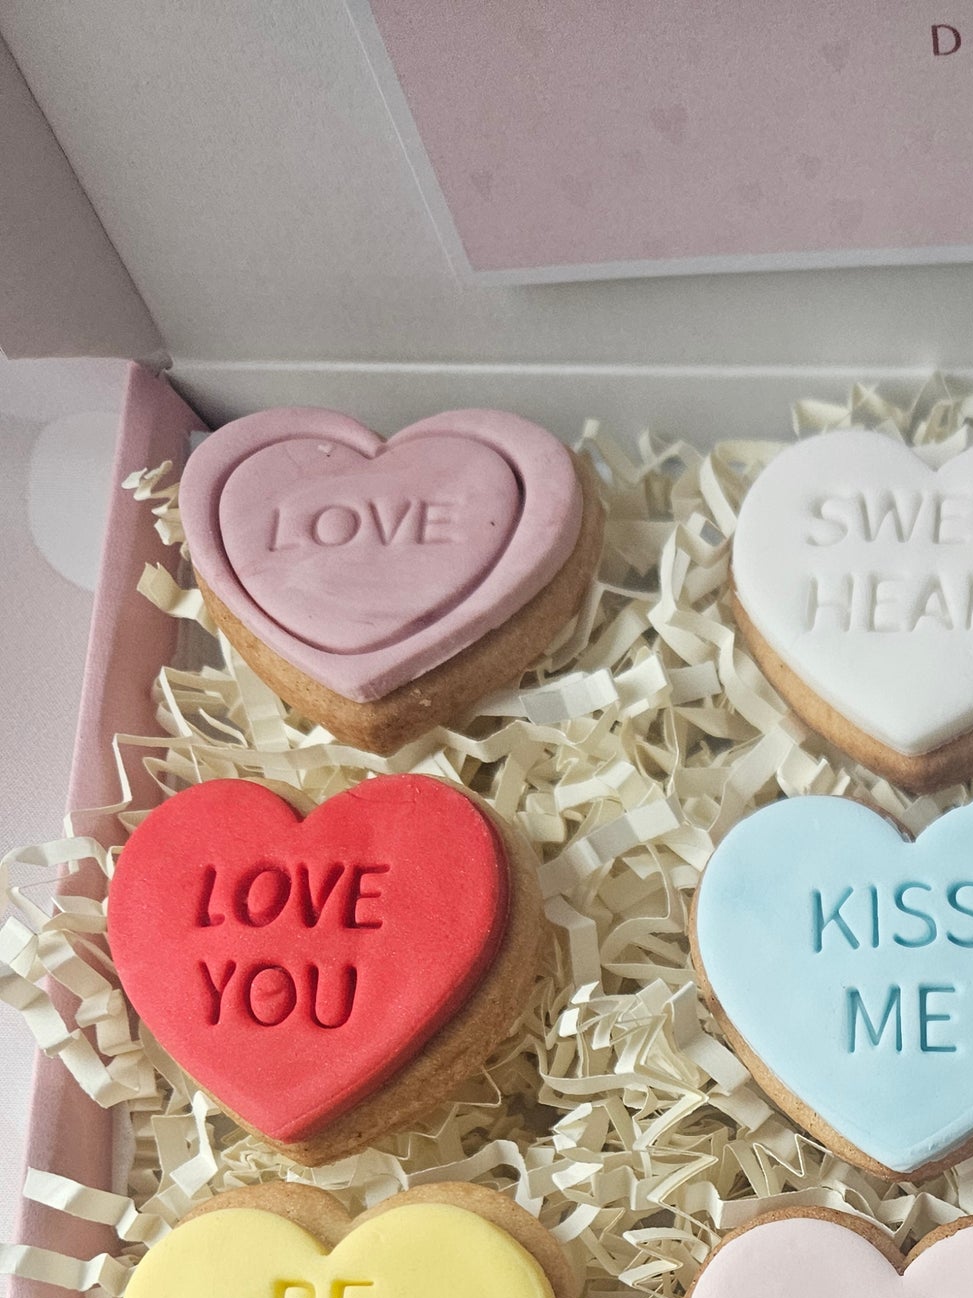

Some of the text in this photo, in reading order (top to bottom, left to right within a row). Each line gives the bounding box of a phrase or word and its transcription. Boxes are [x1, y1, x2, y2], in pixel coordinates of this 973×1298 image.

[266, 497, 465, 554] LOVE
[194, 861, 392, 931] LOVE
[197, 958, 358, 1029] YOU
[845, 985, 959, 1055] ME
